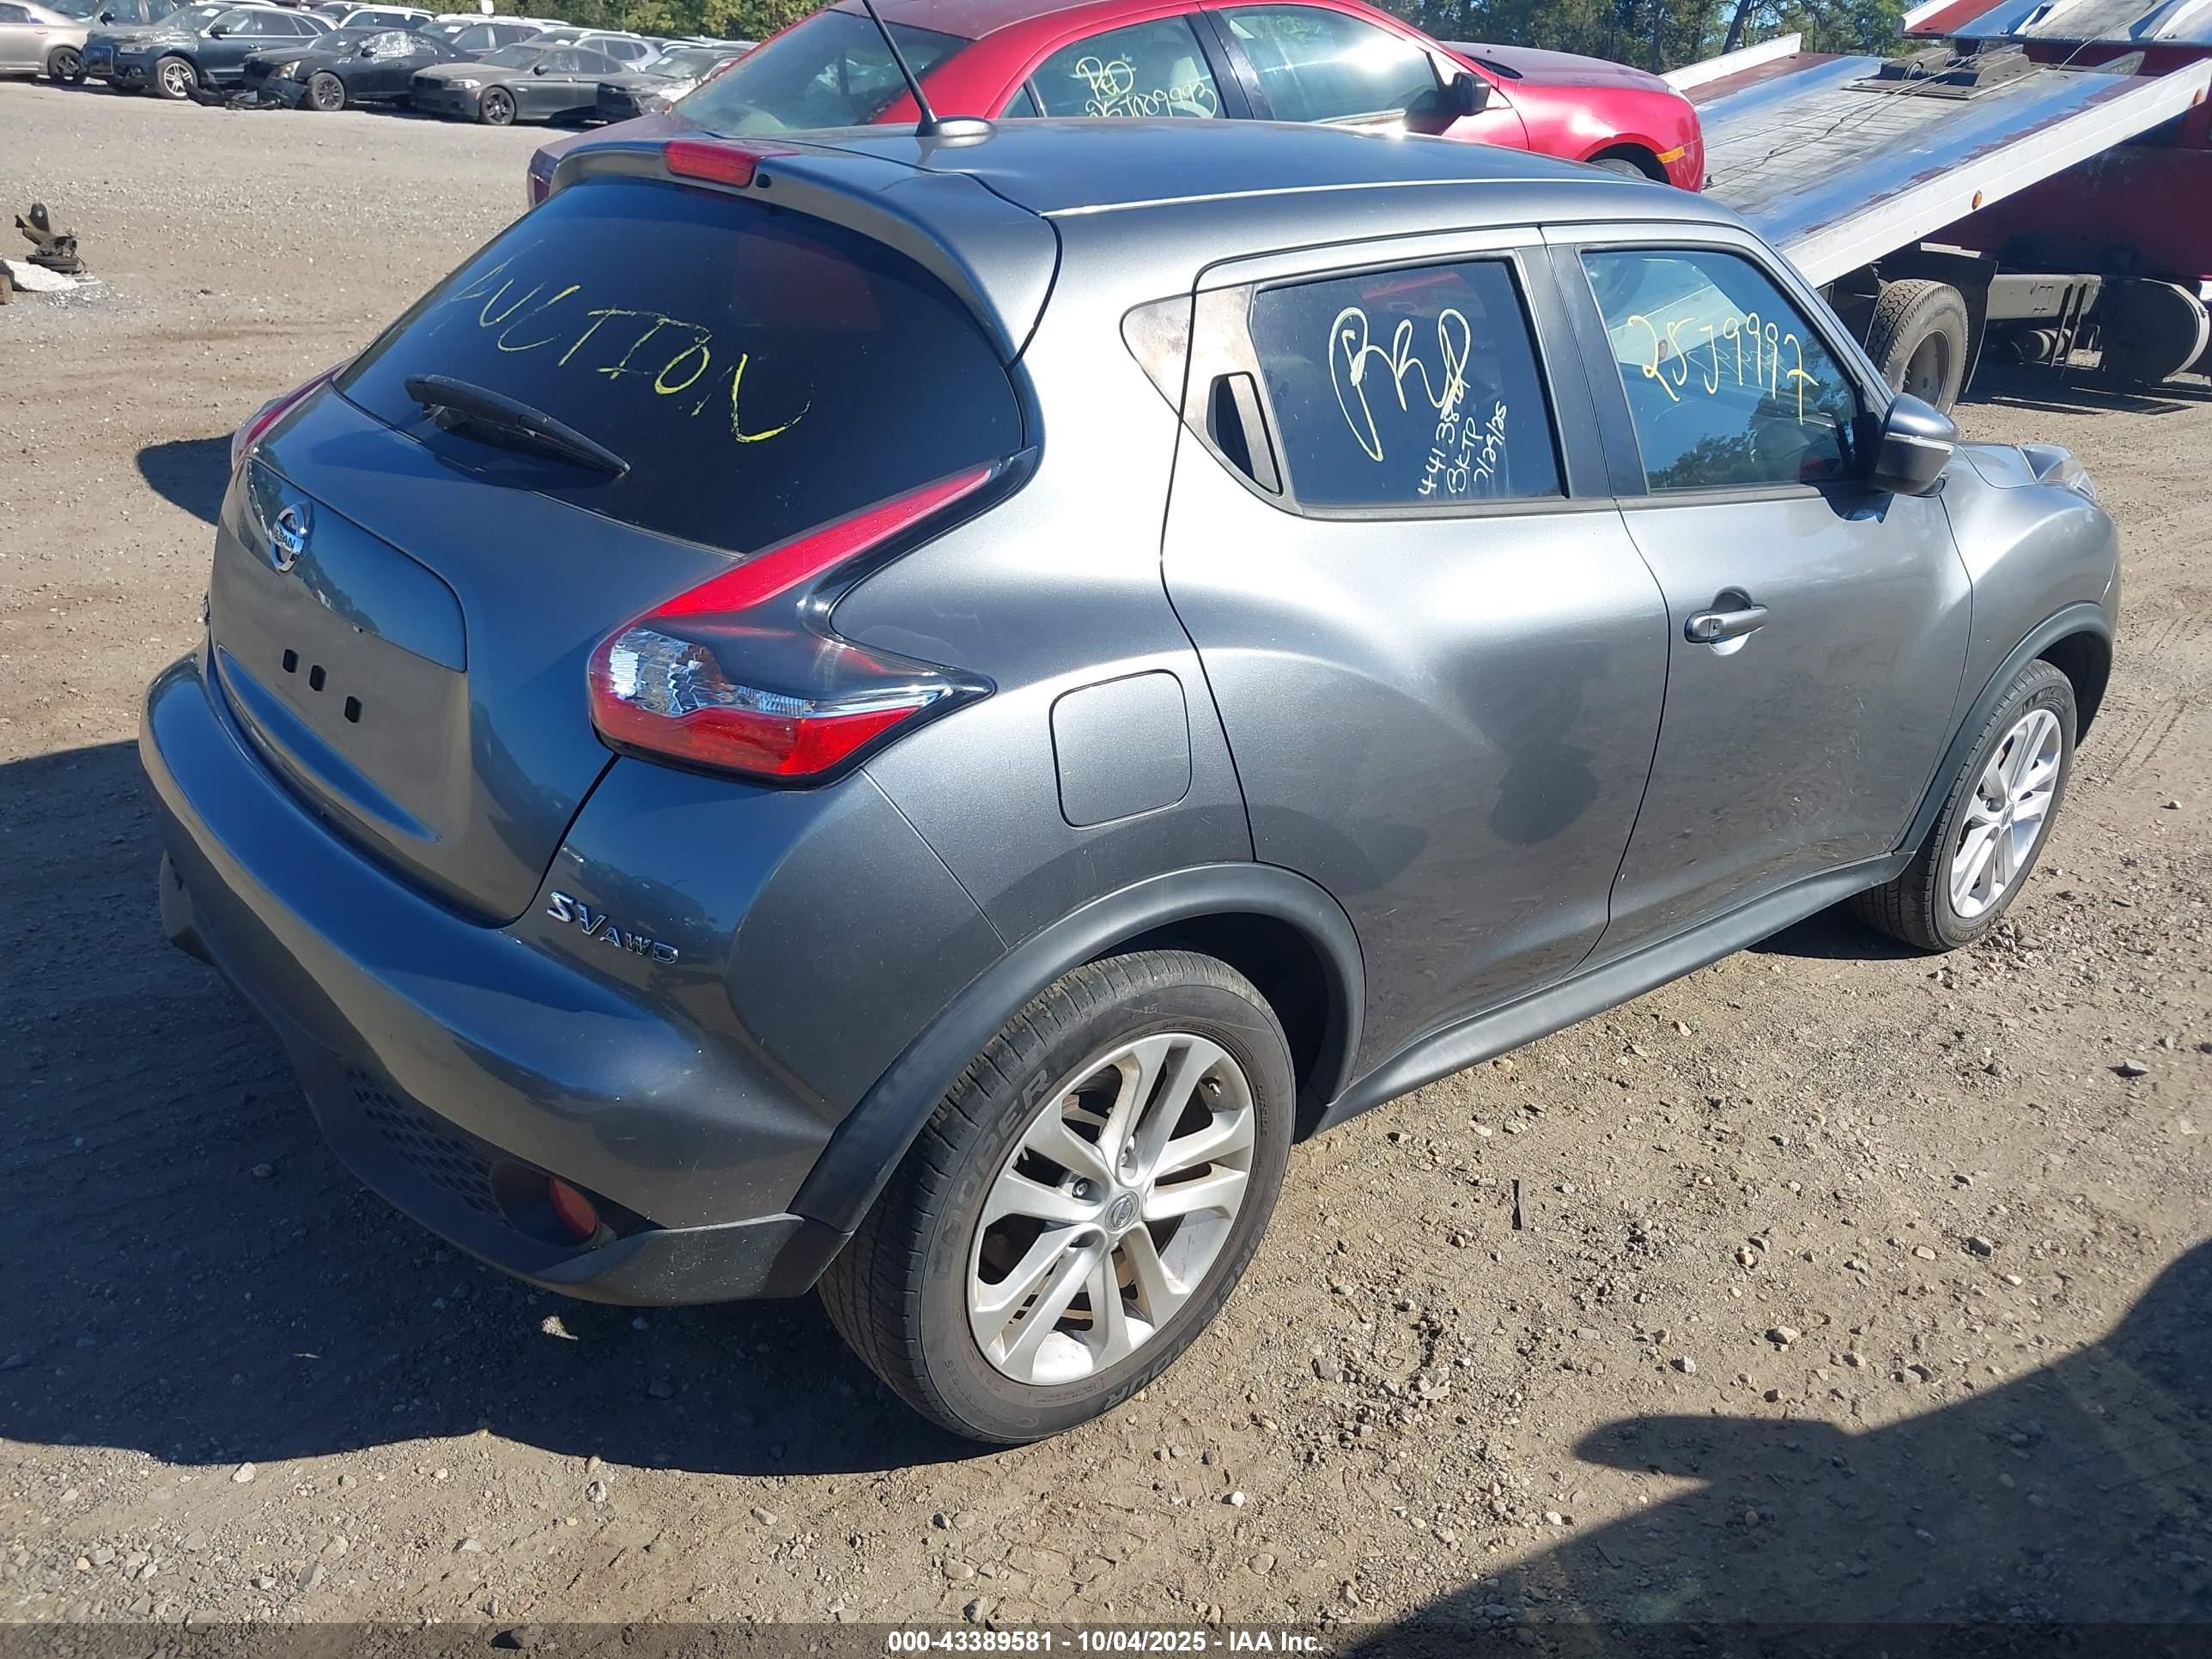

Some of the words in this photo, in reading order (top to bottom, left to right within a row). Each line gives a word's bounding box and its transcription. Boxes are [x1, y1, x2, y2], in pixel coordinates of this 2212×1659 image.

[428, 240, 815, 443] AUCTION
[1473, 399, 1508, 483] 7/29/25
[546, 890, 607, 936] SV
[599, 927, 679, 964] AWD
[932, 1068, 1050, 1281] COOPER
